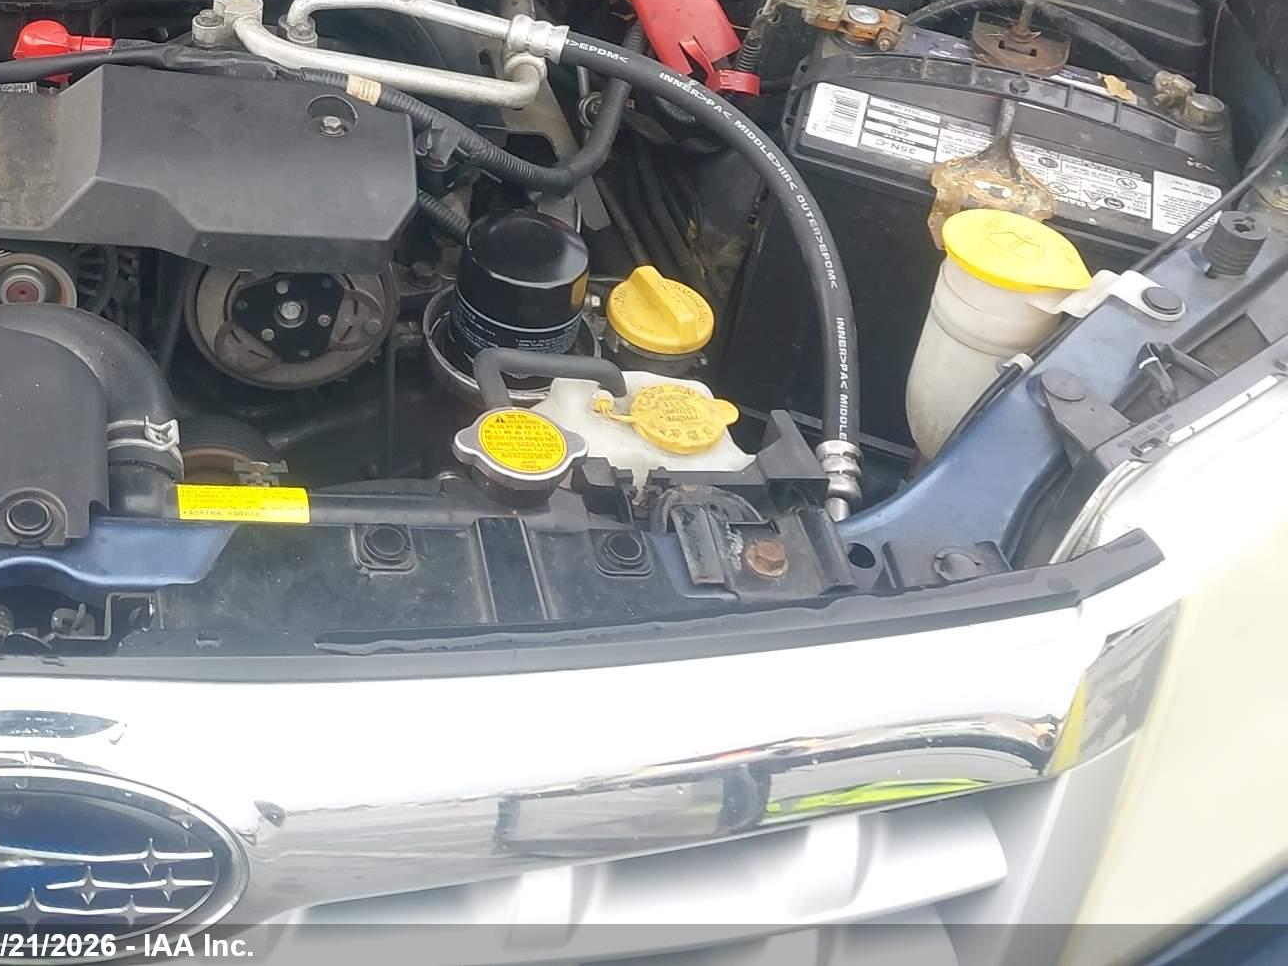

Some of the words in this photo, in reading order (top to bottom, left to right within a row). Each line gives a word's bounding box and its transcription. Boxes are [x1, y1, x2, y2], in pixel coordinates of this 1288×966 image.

[659, 72, 732, 119] INNER>PA<
[734, 120, 798, 191] MIDDLE>IIR<
[796, 194, 838, 289] OUTER>EPDM<
[835, 317, 848, 390] INNER>PA<
